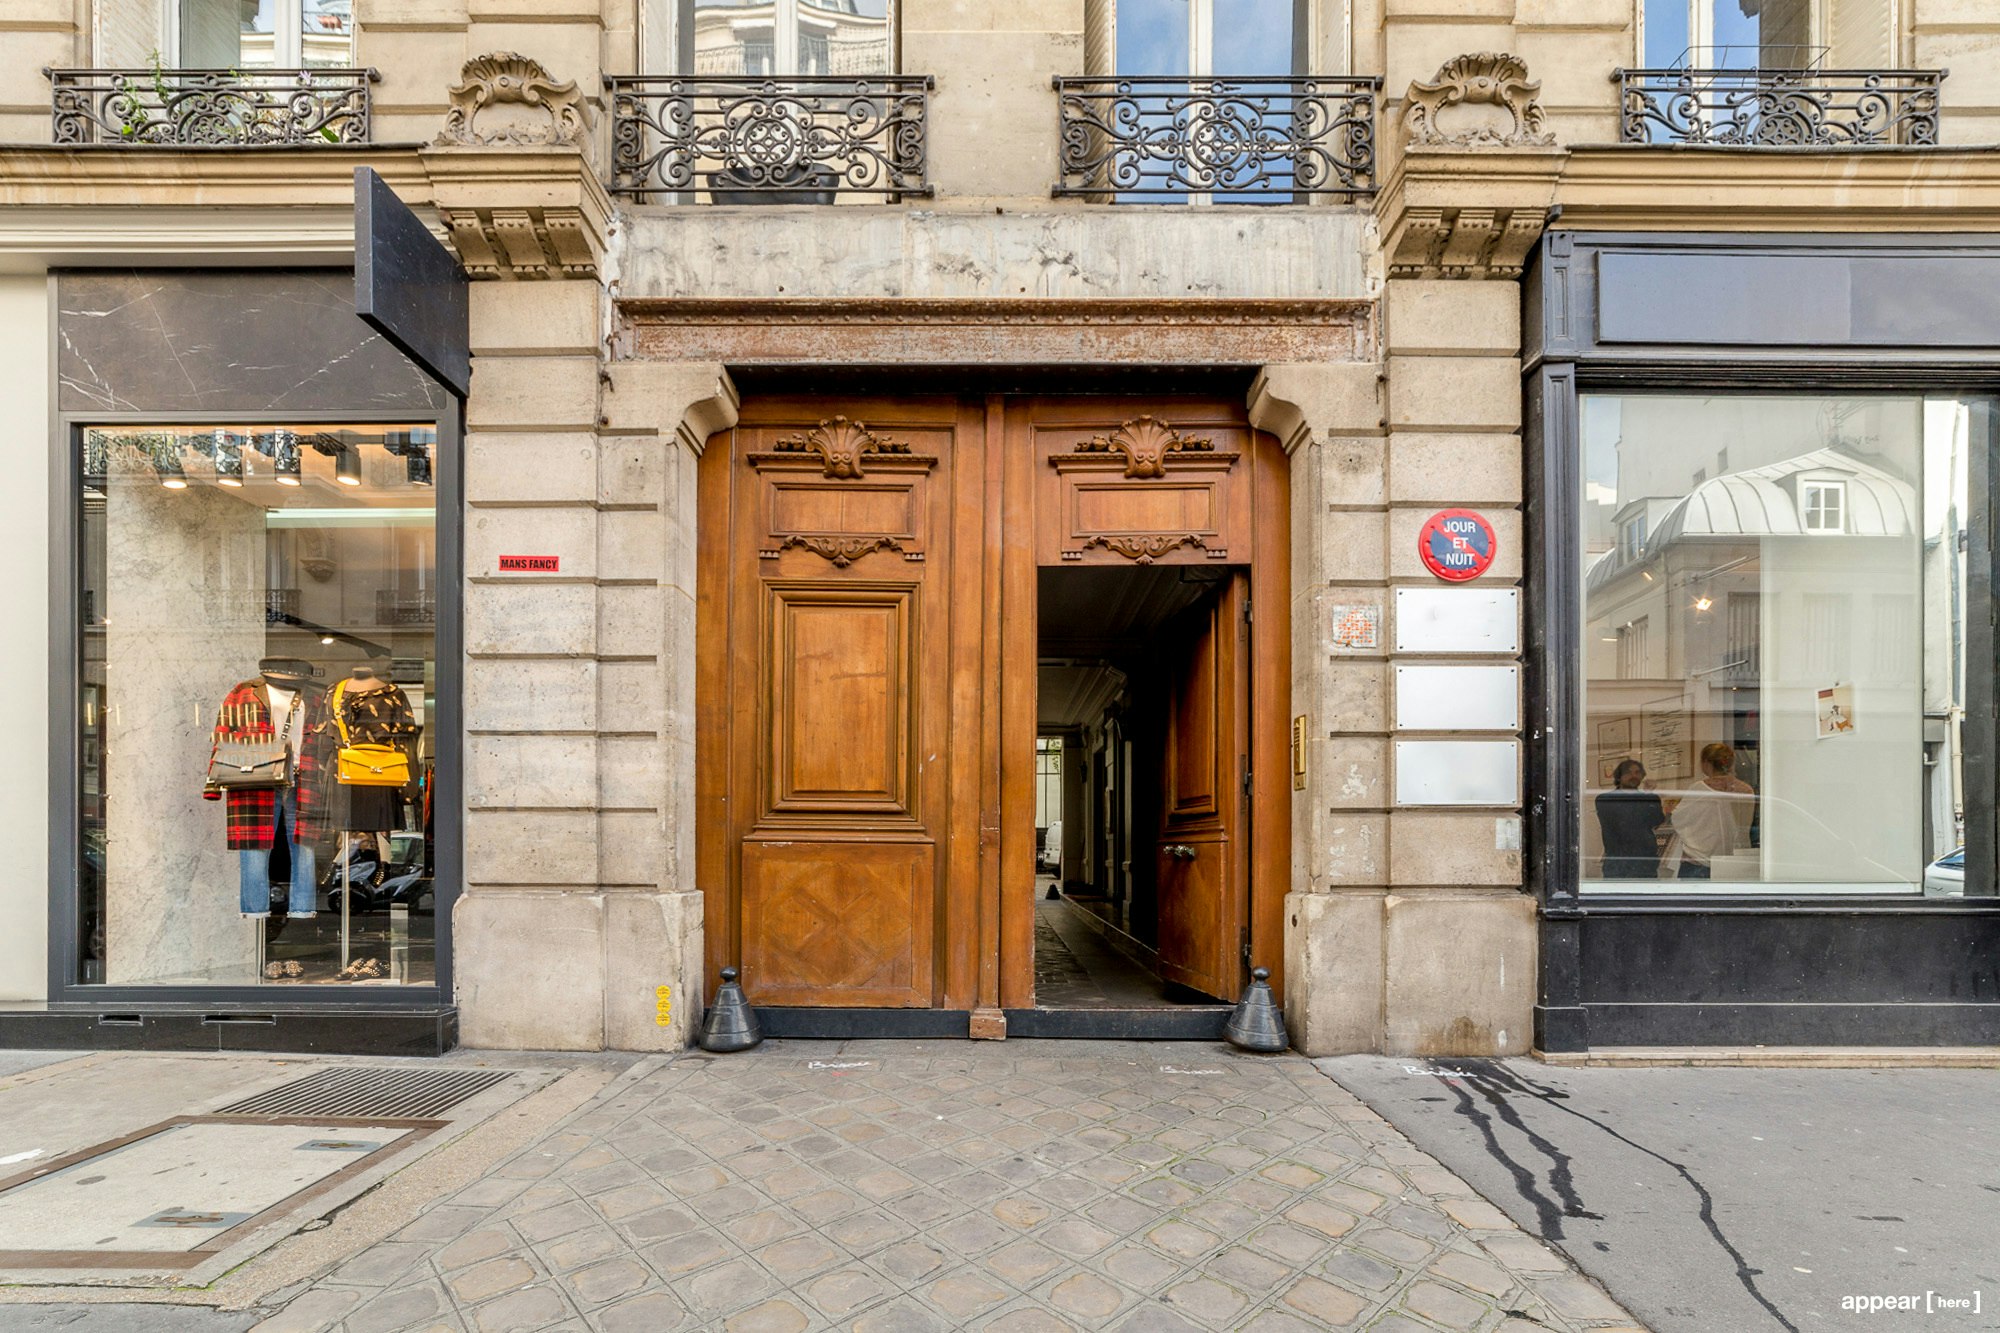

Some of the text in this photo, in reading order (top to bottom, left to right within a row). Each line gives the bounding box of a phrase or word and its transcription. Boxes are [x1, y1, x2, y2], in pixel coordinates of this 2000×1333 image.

[1444, 521, 1476, 533] JOUR
[1453, 537, 1469, 549] ET
[501, 559, 557, 569] MANS FANCY
[1445, 553, 1476, 566] NUIT
